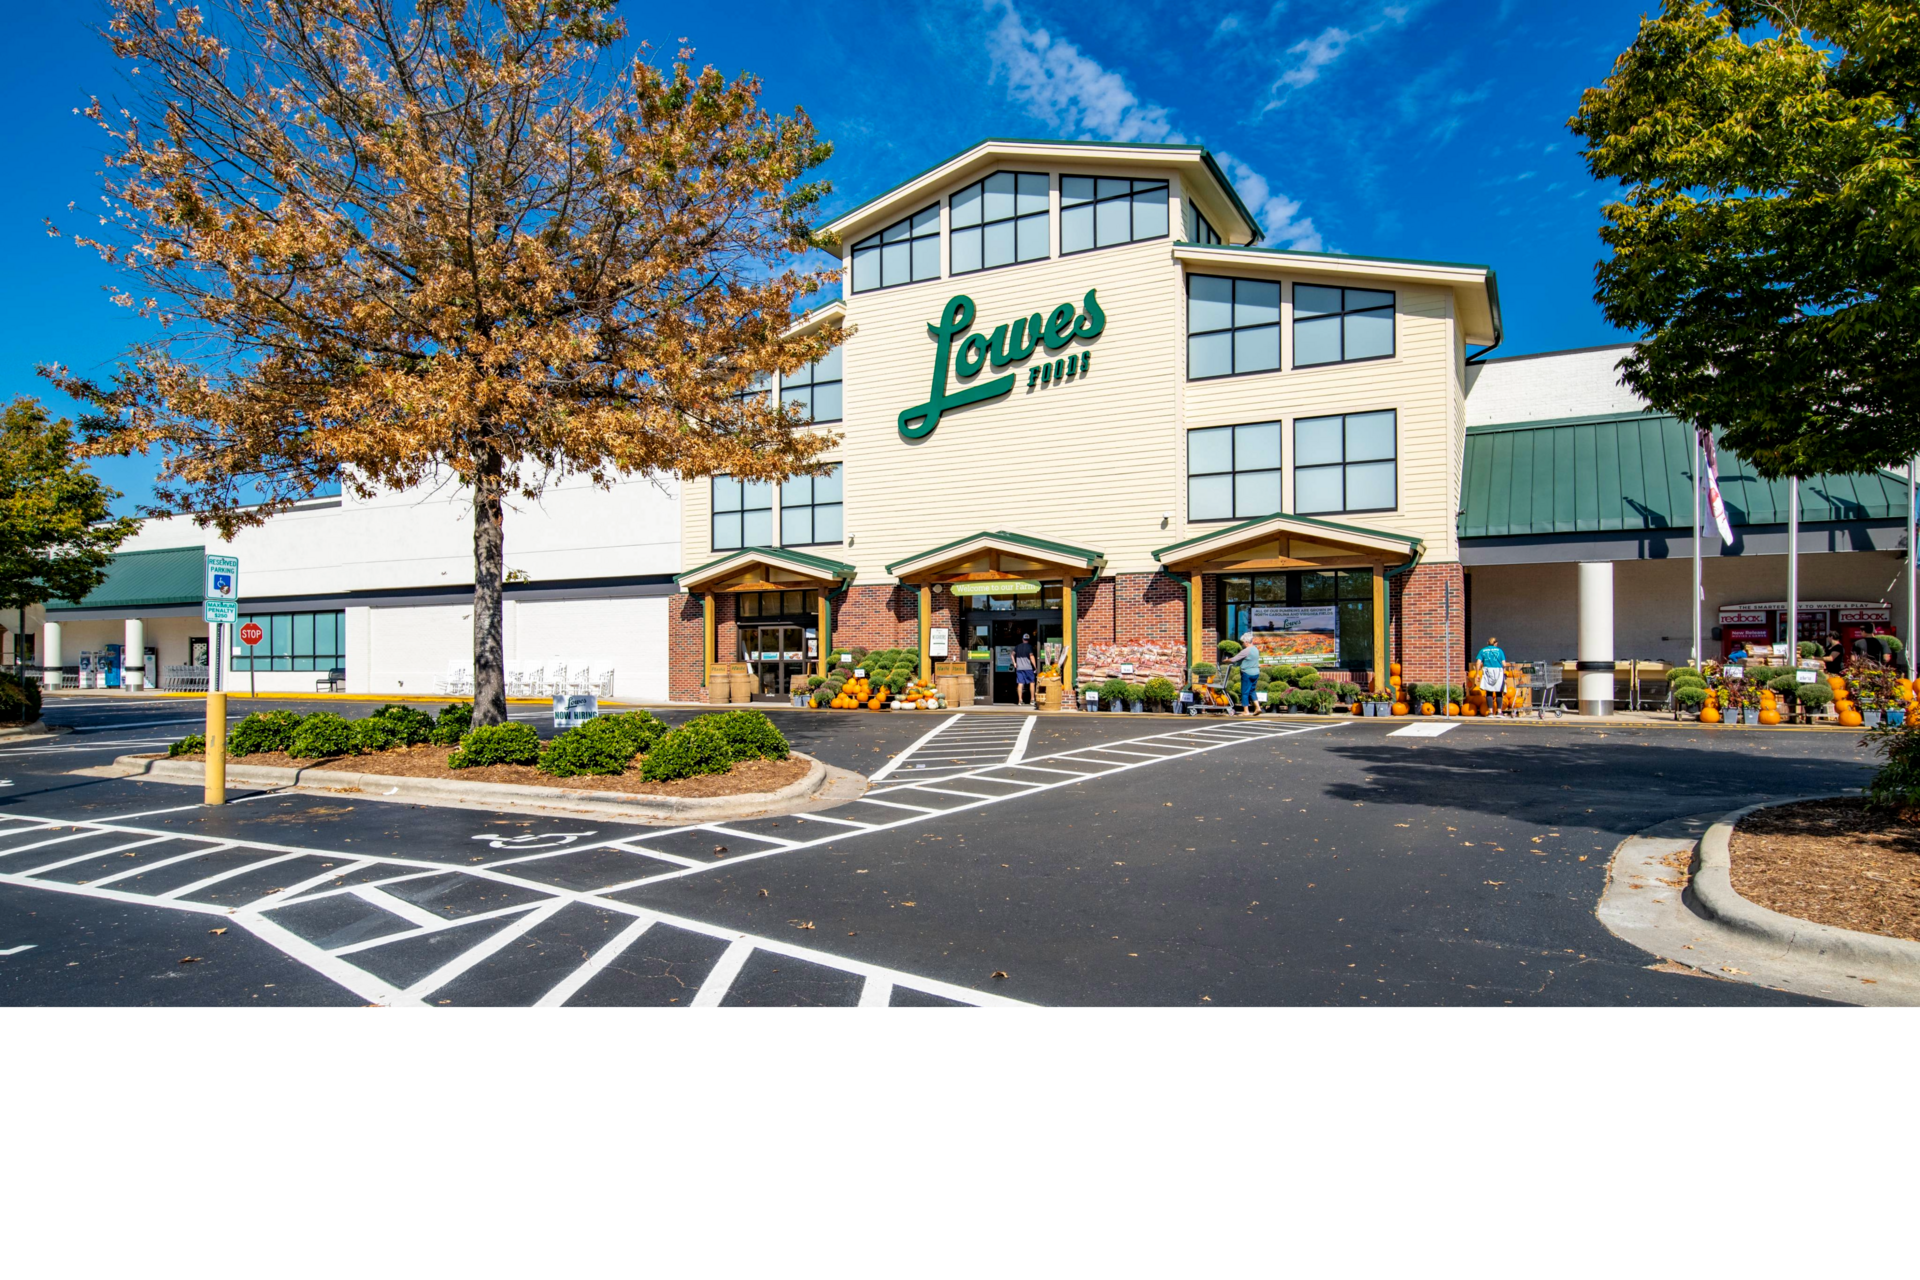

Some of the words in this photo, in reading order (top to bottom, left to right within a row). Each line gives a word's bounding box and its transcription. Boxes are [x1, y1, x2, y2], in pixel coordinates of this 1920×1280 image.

[898, 288, 1106, 439] Lowes
[1027, 350, 1092, 387] FOODS
[209, 558, 237, 567] RESERVED
[210, 566, 235, 574] PARKING
[956, 584, 990, 593] Welcome
[1015, 582, 1036, 590] Farm
[1283, 618, 1302, 629] Lowes
[241, 629, 262, 639] STOP
[564, 697, 587, 710] Lowes
[554, 711, 572, 720] NOW
[573, 711, 598, 720] HIRING
